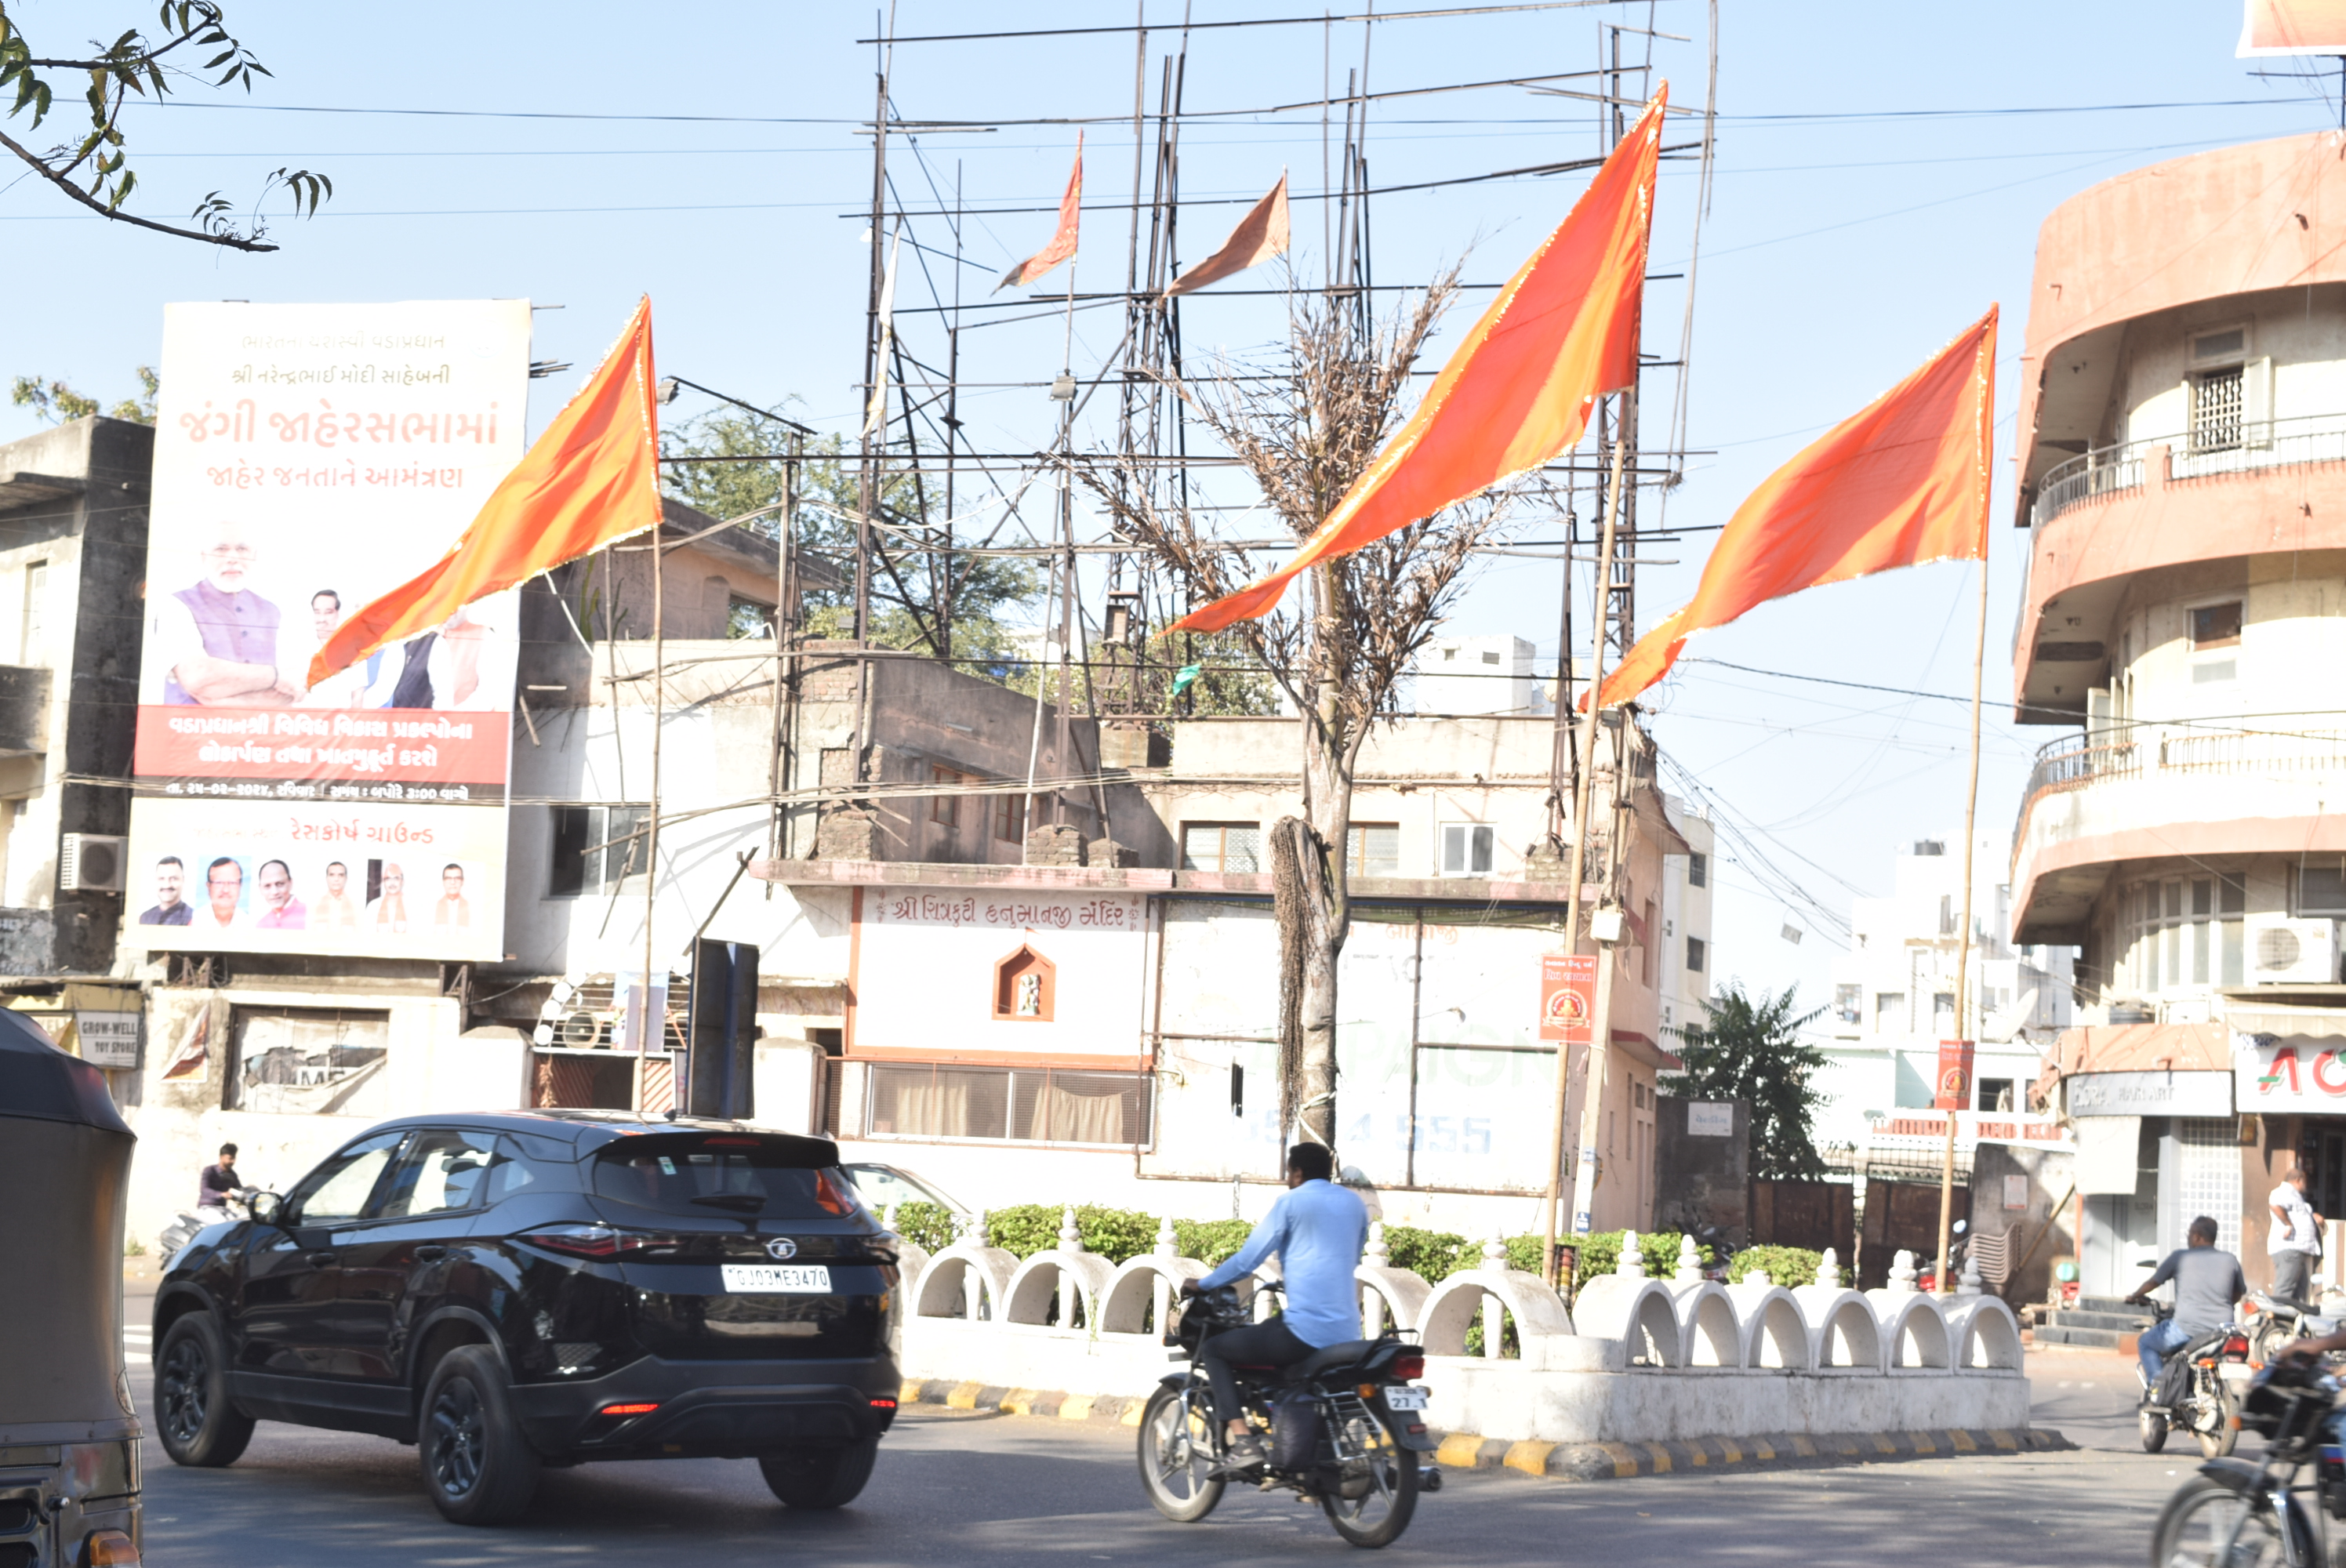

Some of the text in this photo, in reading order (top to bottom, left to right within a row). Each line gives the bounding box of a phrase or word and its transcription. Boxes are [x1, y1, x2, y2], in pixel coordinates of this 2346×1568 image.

[231, 364, 450, 387] શ્રી નરેન્દ્રભાઈ મોદી સાહેબની
[179, 397, 499, 448] જંગી જાહેરસભામાં
[206, 458, 464, 490] જાહેર જનતાને આમંત્રણ
[274, 713, 329, 736] વિવિધ
[275, 746, 311, 764] તથા
[400, 745, 438, 767] કરશે
[366, 820, 434, 845] ગ્રાઉન્ડ
[892, 895, 918, 920] શ્રી
[986, 903, 1073, 929] હનુમાનજી
[1079, 900, 1124, 926] મંદિર
[82, 1021, 136, 1036] GROW-WELL
[2148, 1087, 2175, 1102] ART
